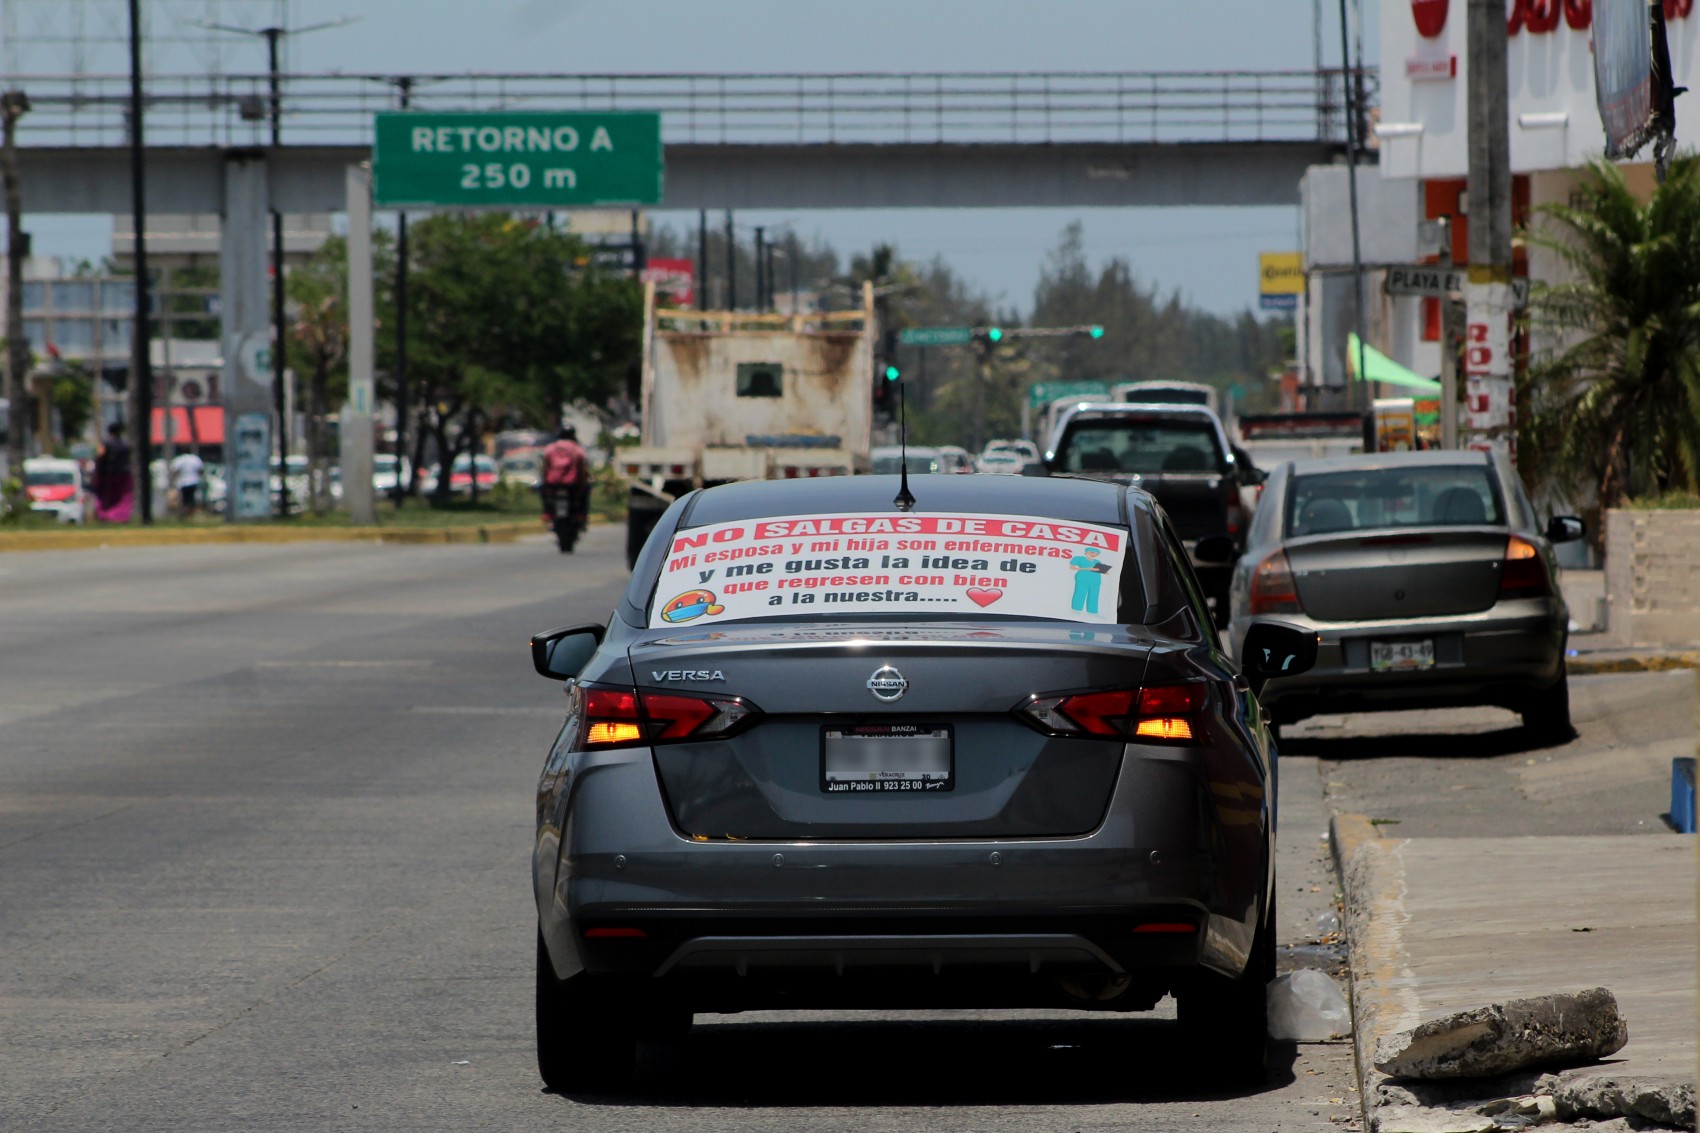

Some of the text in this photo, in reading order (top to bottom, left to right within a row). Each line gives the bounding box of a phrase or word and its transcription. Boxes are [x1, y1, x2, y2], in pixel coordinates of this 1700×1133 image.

[411, 125, 614, 153] RETORNO A
[460, 163, 577, 189] 250 m
[1391, 270, 1440, 290] PLAYA
[672, 518, 1110, 554] NO SALGAS DE CASA
[669, 537, 1073, 573] Mi esposa y mi hija son enfermeras
[698, 555, 1037, 584] y me gusta la idea de
[723, 574, 1008, 595] que regresen con bien
[768, 594, 783, 606] a
[792, 591, 816, 605] la
[651, 669, 727, 683] VERSA
[870, 680, 905, 688] NISSAN
[891, 725, 917, 733] BANZAI
[828, 782, 849, 791] Juan
[850, 781, 874, 791] Pablo
[883, 781, 899, 790] 923
[900, 781, 911, 790] 25
[912, 781, 922, 790] 00
